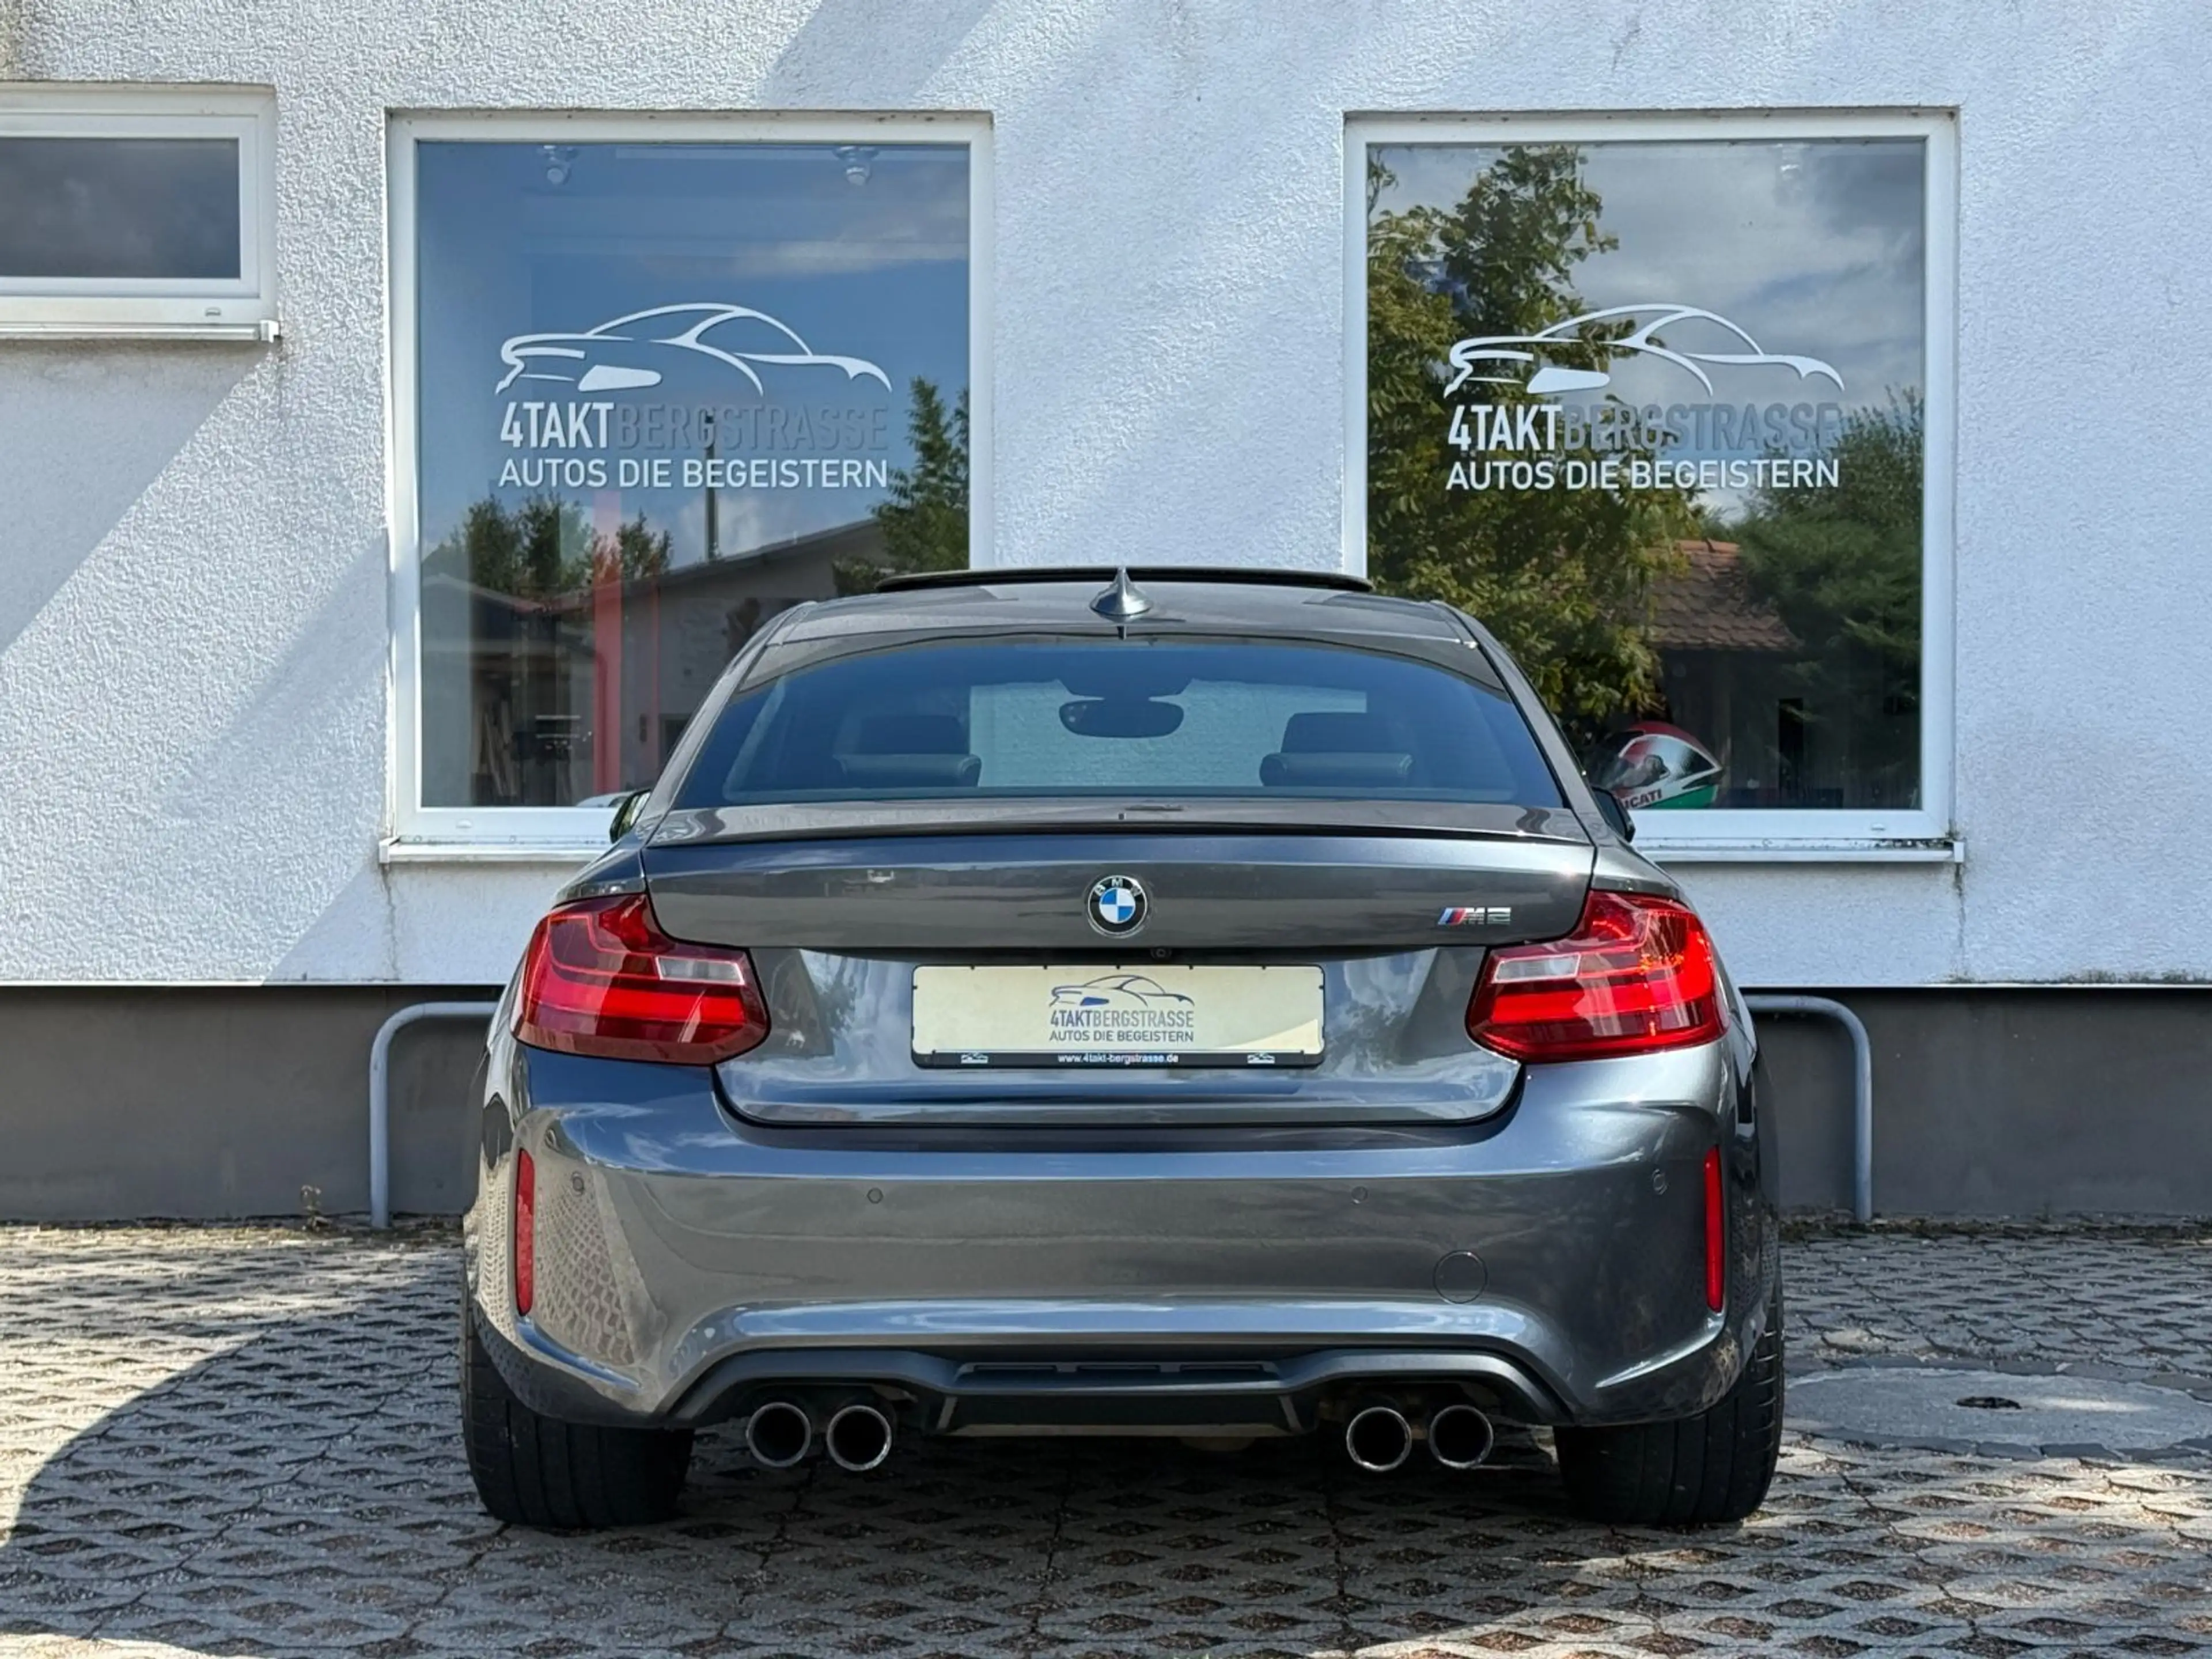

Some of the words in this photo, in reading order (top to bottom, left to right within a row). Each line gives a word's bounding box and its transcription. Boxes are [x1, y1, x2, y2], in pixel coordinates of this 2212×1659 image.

[500, 402, 889, 450] 4TAKTBERGSTRASSE
[1448, 403, 1843, 451] 4TAKTBERGSTRASSE
[499, 459, 608, 487] AUTOS
[619, 460, 672, 487] DIE
[682, 459, 888, 488] BEGEISTERN
[1446, 461, 1554, 490] AUTOS
[1566, 461, 1619, 489] DIE
[1631, 459, 1839, 490] BEGEISTERN
[1619, 789, 1662, 808] UCATI
[1094, 877, 1142, 897] BMW
[1460, 907, 1512, 925] M2
[1050, 1010, 1194, 1027] 4TAKTBERGSTRASSE
[1049, 1030, 1090, 1041] AUTOS
[1093, 1030, 1113, 1041] DIE
[1117, 1030, 1194, 1043] BEGEISTERN
[1058, 1054, 1179, 1065] www.4takt-bergstrasse.de
